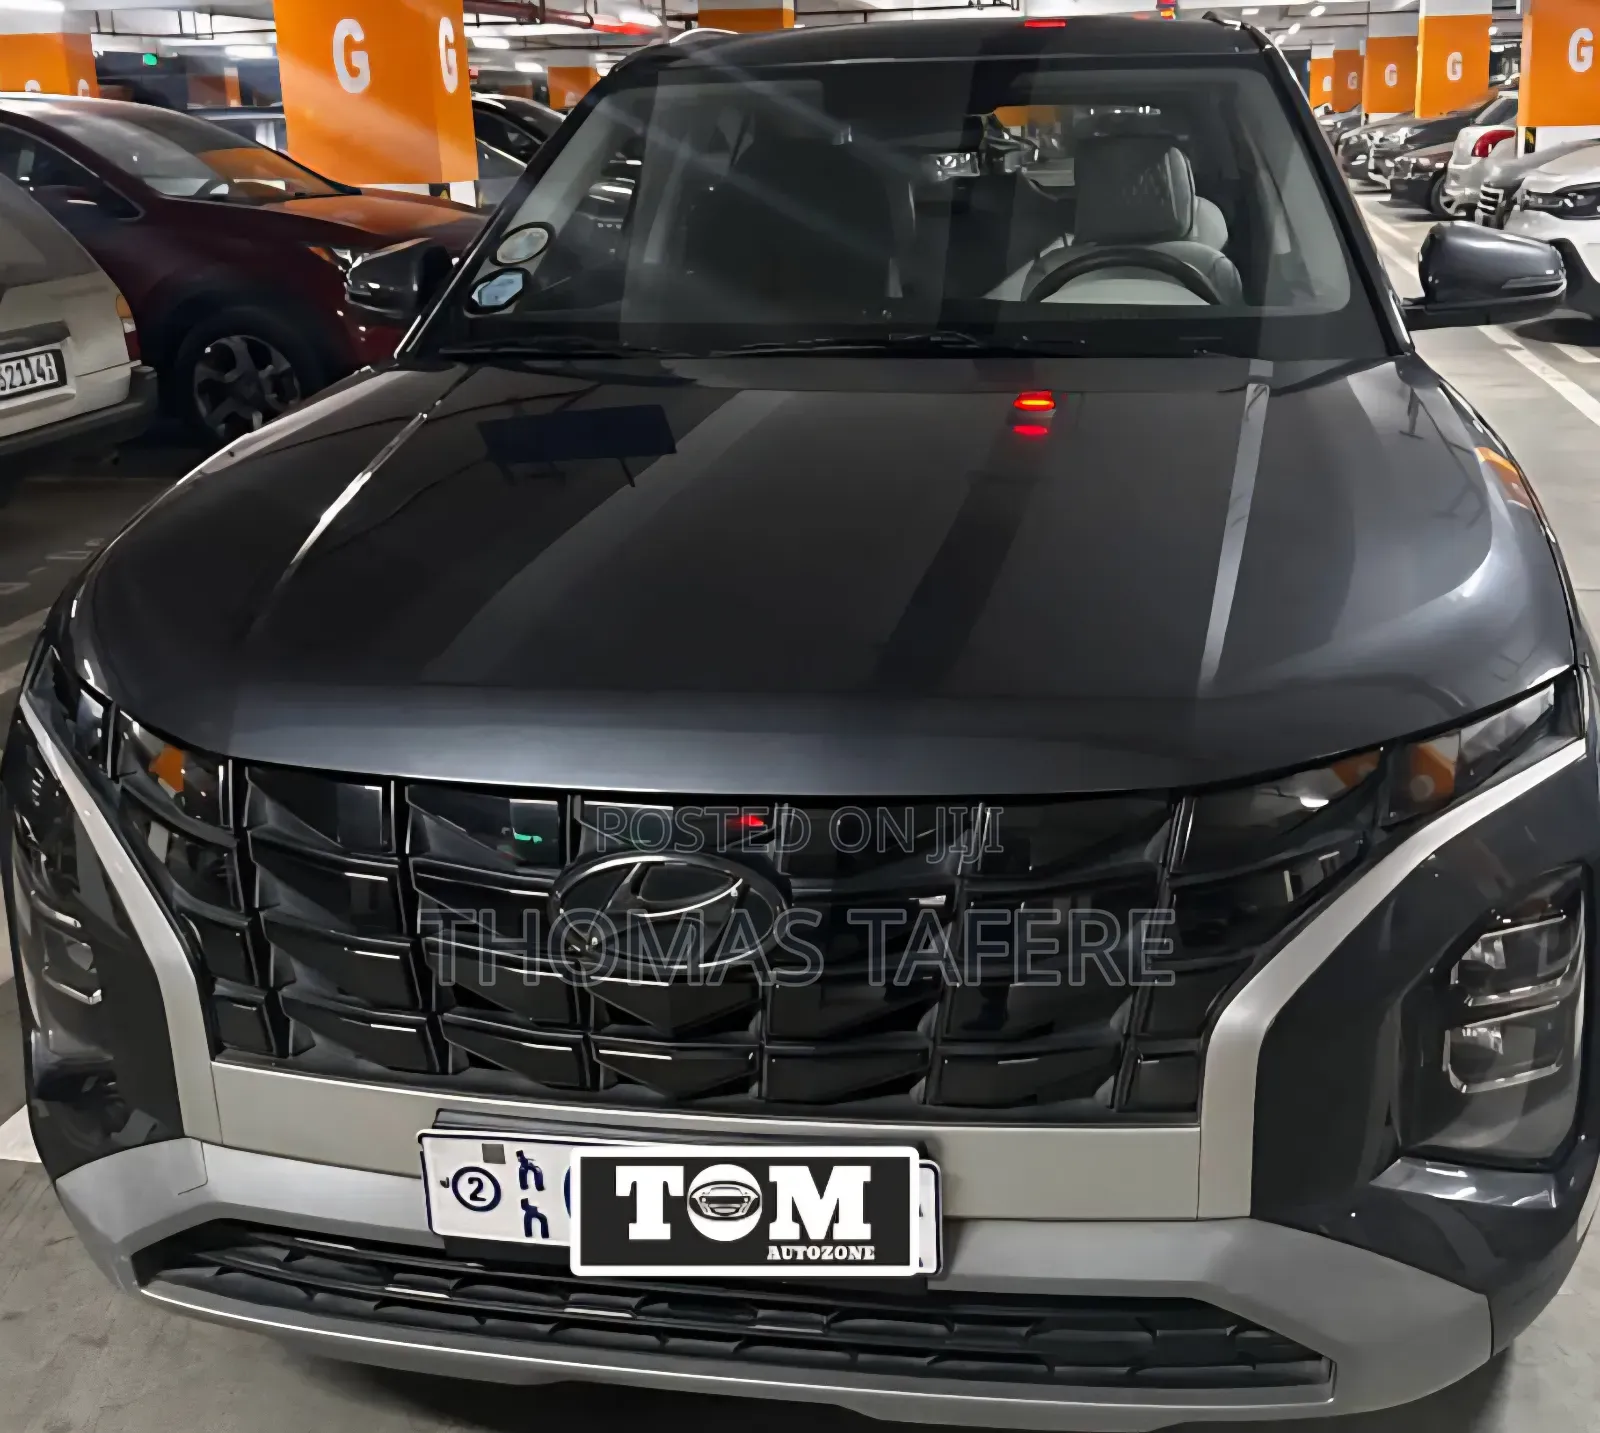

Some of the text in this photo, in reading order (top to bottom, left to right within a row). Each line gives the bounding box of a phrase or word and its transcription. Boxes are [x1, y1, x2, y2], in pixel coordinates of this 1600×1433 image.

[333, 18, 371, 94] G
[438, 16, 459, 94] G
[1446, 51, 1463, 82] G
[1568, 27, 1594, 73] G
[1384, 63, 1398, 87] G
[467, 1176, 487, 1202] 2
